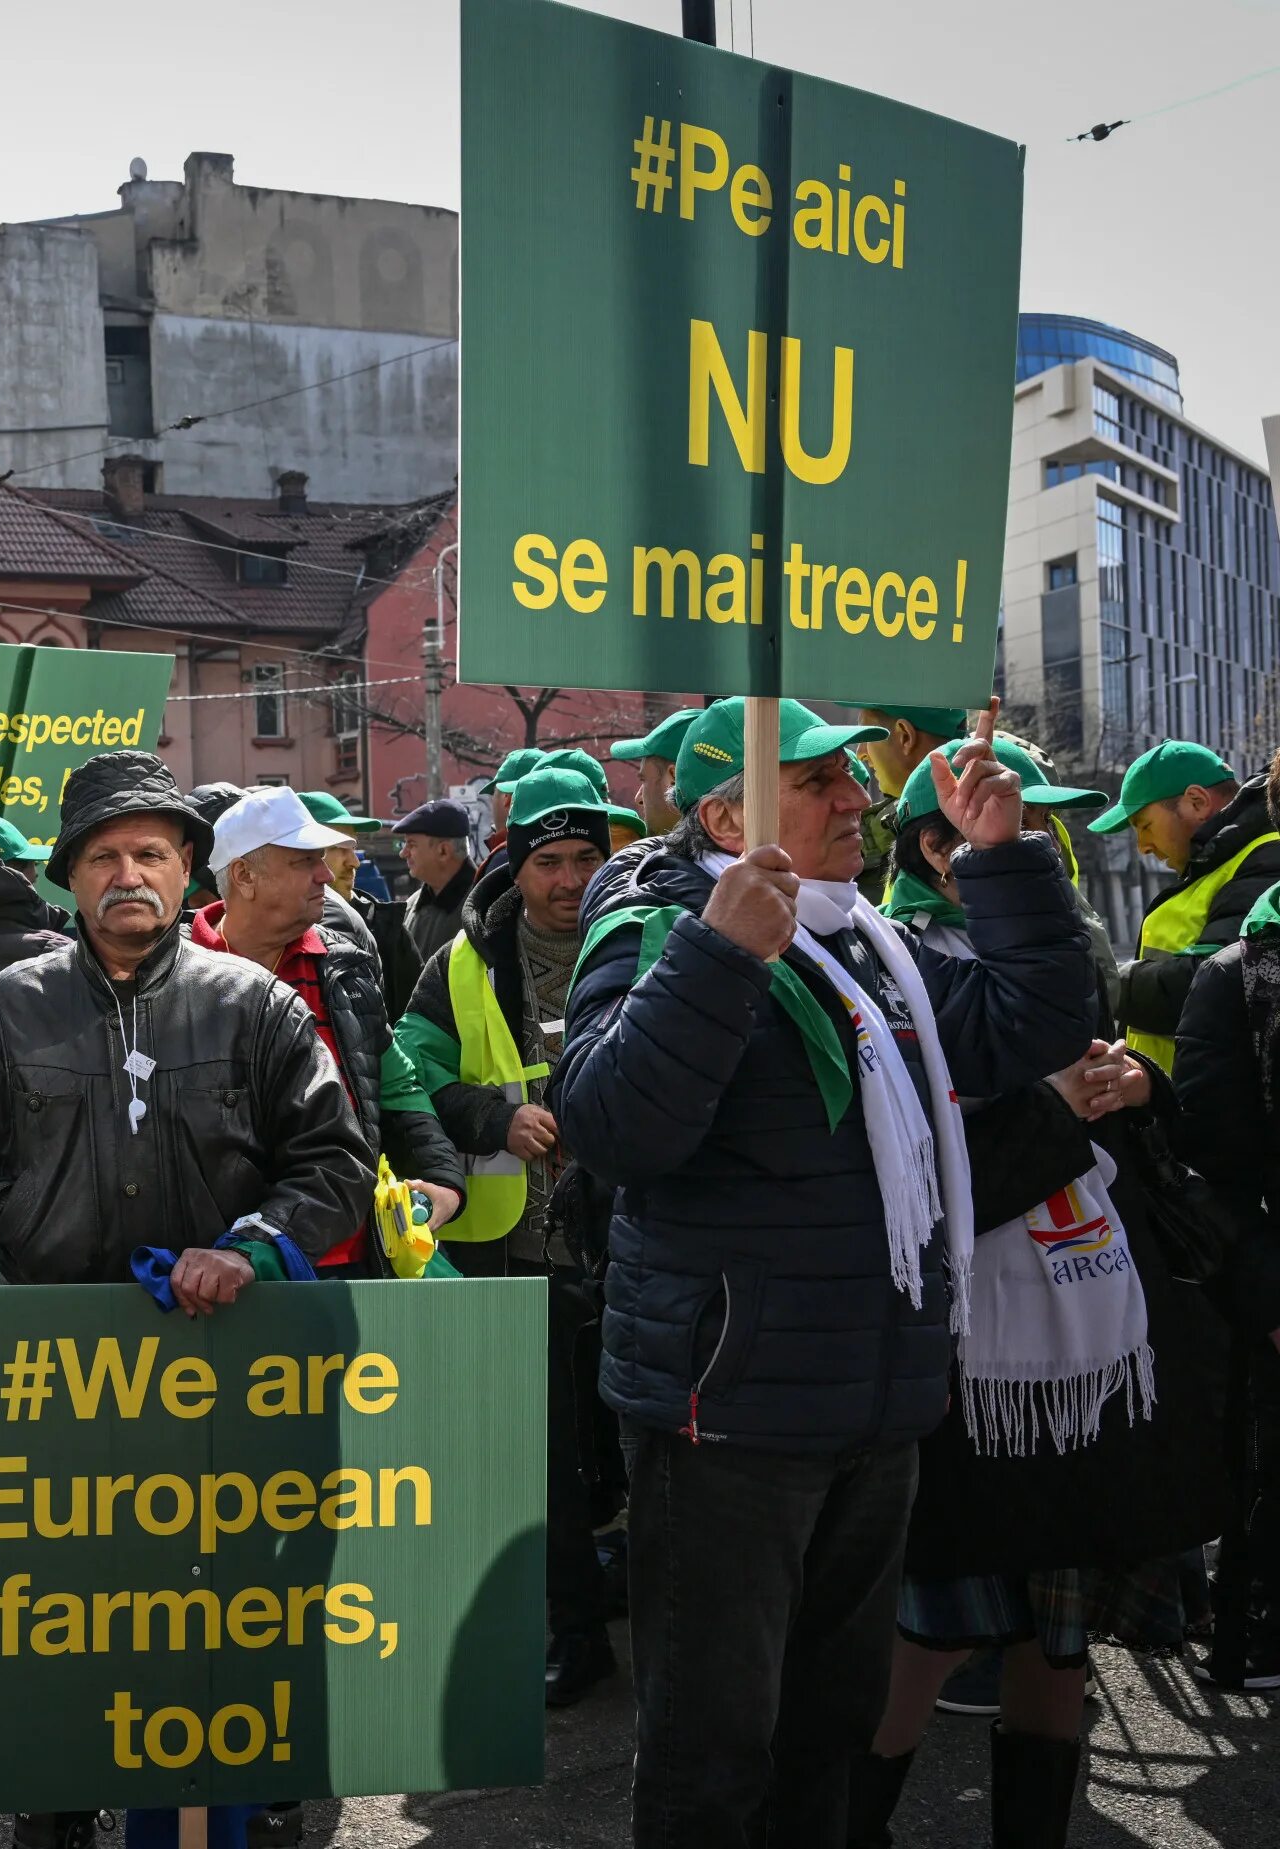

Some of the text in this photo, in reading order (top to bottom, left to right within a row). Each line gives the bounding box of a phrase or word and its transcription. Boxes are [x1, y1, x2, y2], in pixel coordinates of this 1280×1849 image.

[631, 116, 906, 269] #Pe aici
[688, 318, 854, 485] NU
[512, 533, 609, 614] se
[632, 533, 764, 626] mai
[783, 543, 939, 641] trece
[529, 827, 589, 848] Mercedes-Benz
[1051, 1247, 1131, 1285] ARCA
[0, 1336, 400, 1422] #We are
[104, 1680, 291, 1769] too!
